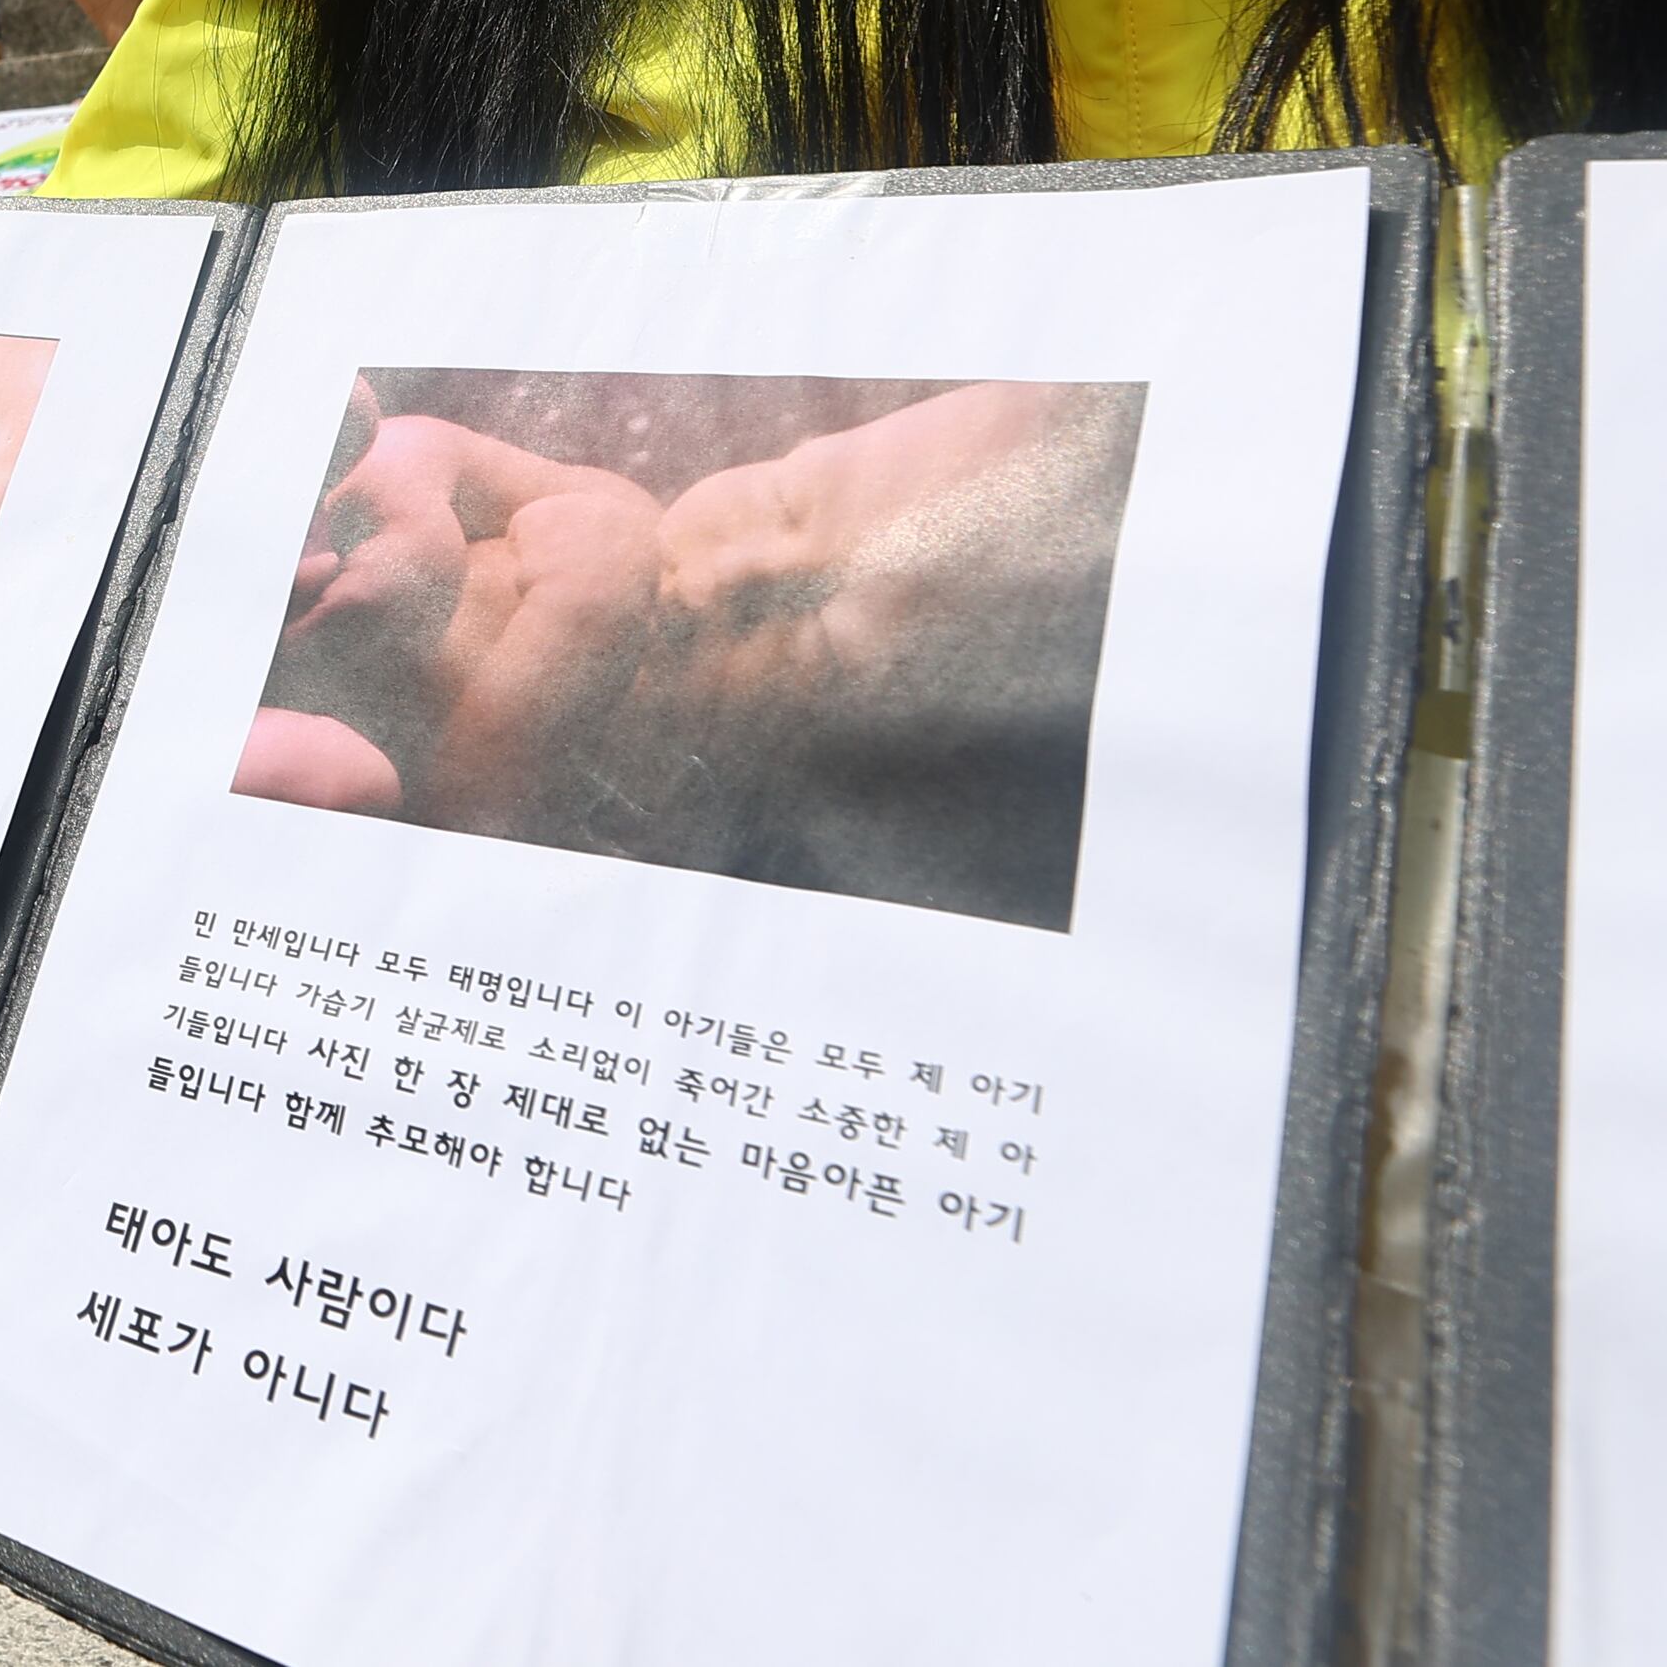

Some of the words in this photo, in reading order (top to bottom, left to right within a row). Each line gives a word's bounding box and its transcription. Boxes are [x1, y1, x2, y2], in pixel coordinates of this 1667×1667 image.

[179, 956, 277, 997] 들입니다
[296, 983, 375, 1021] 가습기
[396, 1006, 505, 1050] 살균제로
[528, 1037, 650, 1085] 소리없이
[674, 1068, 774, 1118] 죽어간
[798, 1098, 905, 1149] 소중한
[935, 1128, 967, 1159] 제
[1001, 1143, 1035, 1174] 아
[195, 911, 216, 938] 민
[233, 919, 360, 967] 만세입니다
[375, 951, 428, 981] 모두
[449, 965, 594, 1017] 태명입니다
[615, 1001, 642, 1028] 이
[664, 1010, 791, 1064] 아기들은
[816, 1044, 883, 1079] 모두
[911, 1062, 942, 1093] 제
[972, 1075, 1042, 1113] 아기
[148, 1056, 266, 1113] 들입니다
[286, 1091, 346, 1136] 함께
[365, 1114, 503, 1177] 추모해야
[525, 1156, 631, 1211] 합니다
[163, 1005, 287, 1055] 기들입니다
[308, 1038, 370, 1080] 사진
[395, 1056, 424, 1094] 한
[447, 1070, 481, 1109] 장
[503, 1084, 608, 1136] 제대로
[639, 1117, 710, 1168] 없는
[742, 1143, 904, 1217] 마음아픈
[939, 1192, 1023, 1242] 아기
[77, 1291, 213, 1375] 세포가
[244, 1349, 389, 1439] 아니다
[105, 1202, 232, 1278] 태아도
[265, 1256, 467, 1358] 사람이다
